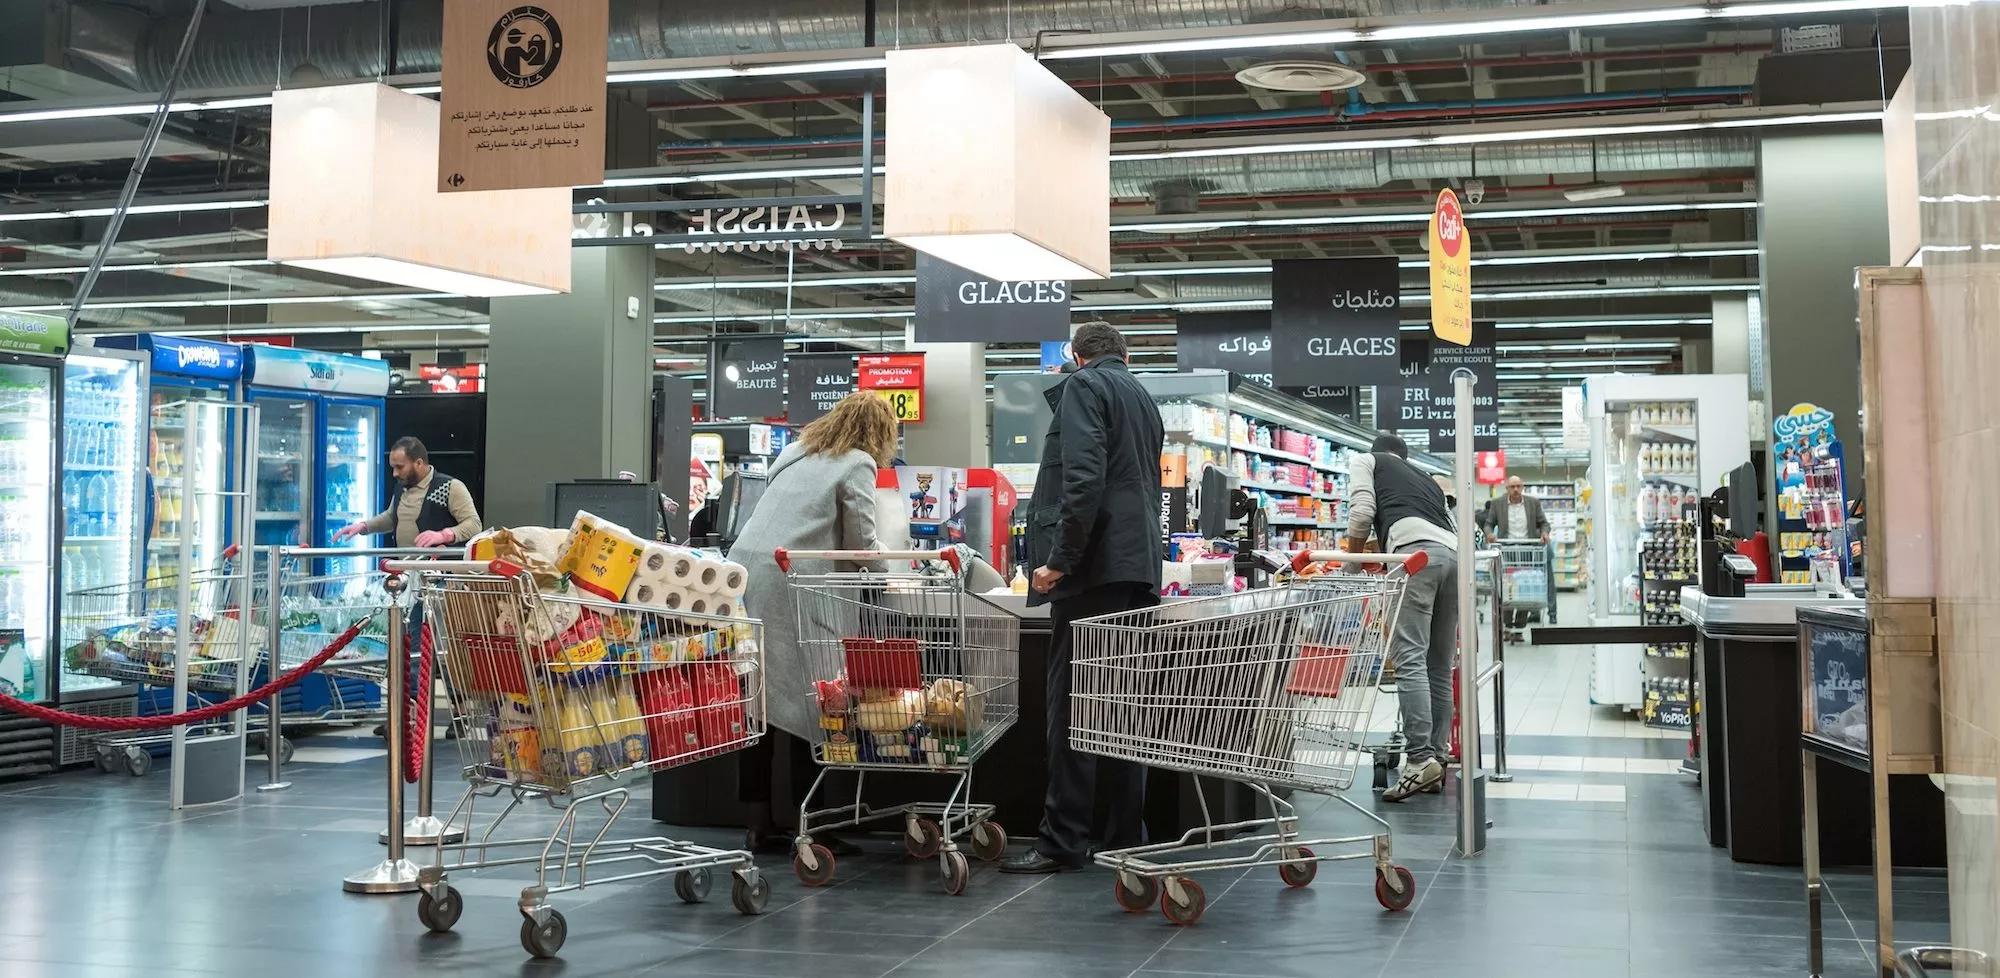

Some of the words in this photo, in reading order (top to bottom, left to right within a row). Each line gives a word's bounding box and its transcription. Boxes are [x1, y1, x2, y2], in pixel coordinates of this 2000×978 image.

[502, 74, 544, 88] كارفور
[580, 105, 594, 113] عند
[958, 281, 1066, 304] GLACES
[1332, 289, 1396, 312] مثلجات
[1218, 335, 1272, 356] فواكه
[1307, 337, 1396, 356] GLACES
[1433, 347, 1464, 355] SERVICE
[1464, 347, 1491, 355] CLIENT
[746, 360, 778, 373] تجميل
[1432, 356, 1439, 364] A
[1439, 356, 1463, 364] VOTRE
[1463, 356, 1493, 364] ECOUTE
[868, 368, 913, 376] PROMOTION
[736, 377, 777, 389] BEAUTÉ
[810, 390, 850, 400] HYGIÈNE
[889, 393, 907, 419] 18
[907, 410, 919, 419] 95
[1401, 406, 1424, 420] DE
